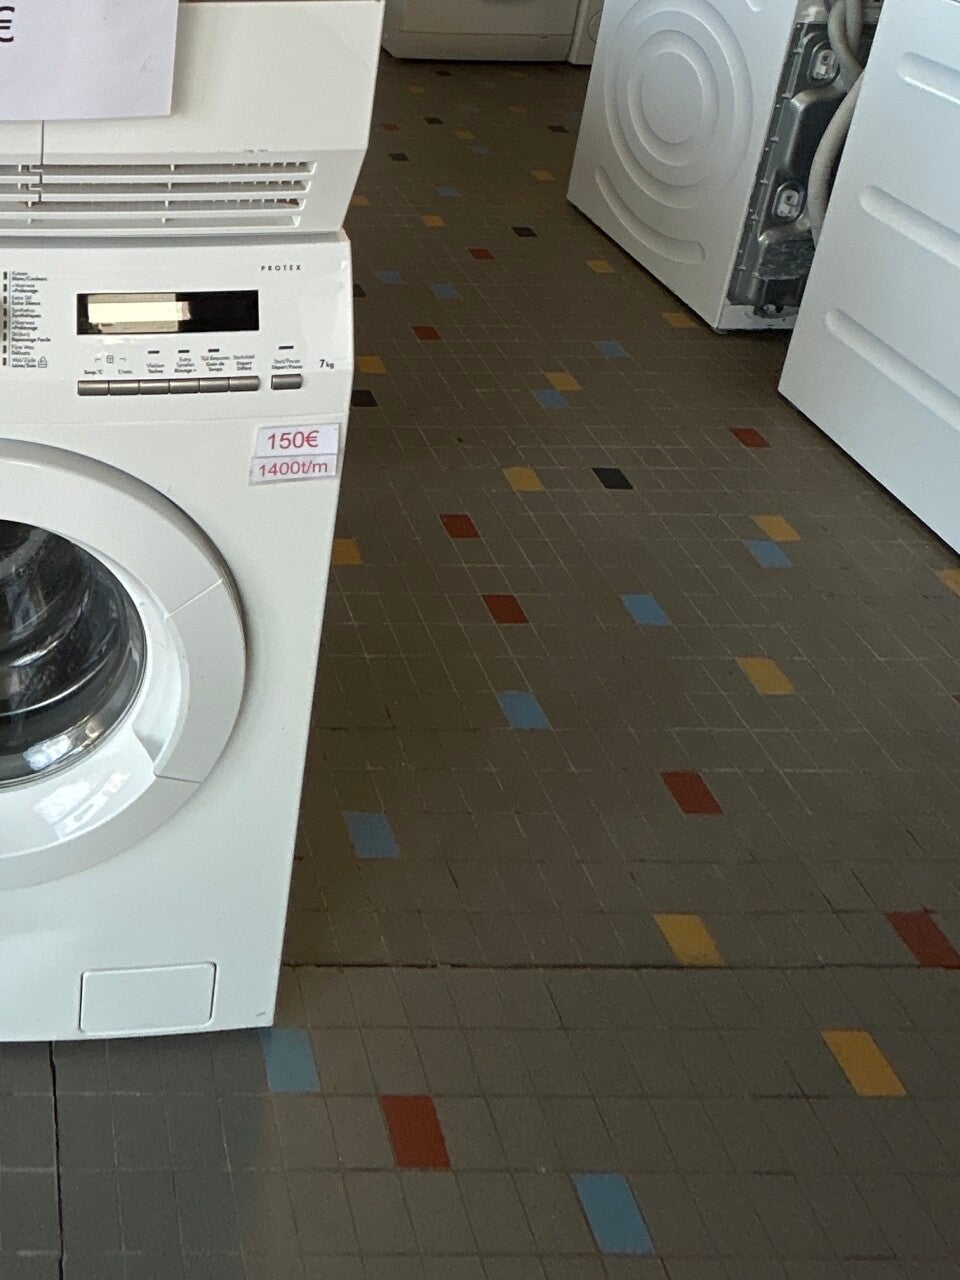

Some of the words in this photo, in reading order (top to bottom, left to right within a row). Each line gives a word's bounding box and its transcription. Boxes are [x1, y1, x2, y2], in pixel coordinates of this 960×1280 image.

[320, 359, 326, 368] 7
[326, 361, 334, 370] kg
[267, 430, 319, 450] 150€
[258, 460, 328, 478] 1400t/m
